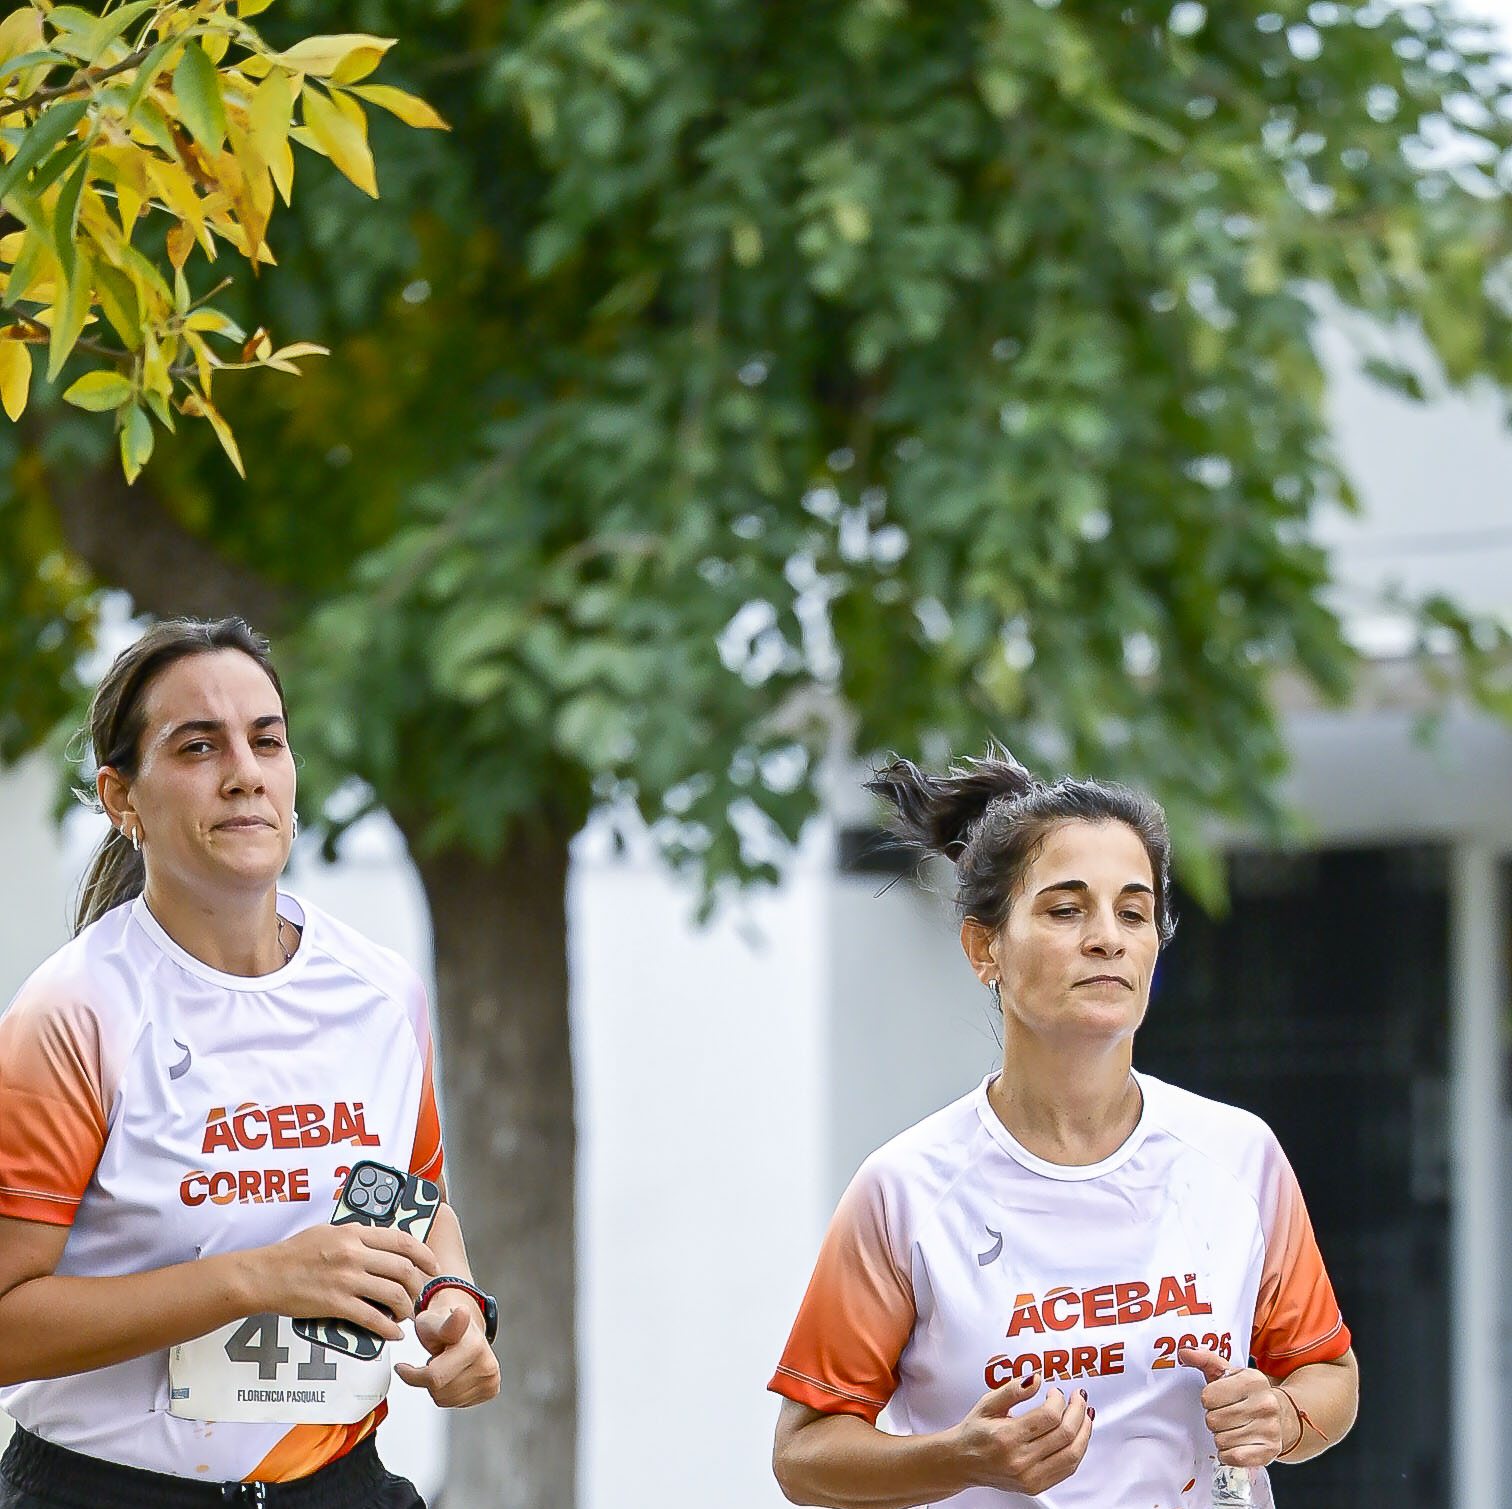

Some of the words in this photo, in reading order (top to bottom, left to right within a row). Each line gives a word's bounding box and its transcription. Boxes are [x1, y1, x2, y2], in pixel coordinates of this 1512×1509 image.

[202, 1102, 380, 1153] ACEBAL
[180, 1168, 310, 1206] CORRE
[1006, 1273, 1212, 1337] ACEBAL
[985, 1342, 1125, 1390] CORRE
[237, 1389, 285, 1402] FLORENCIA
[286, 1390, 326, 1403] PASQUALE
